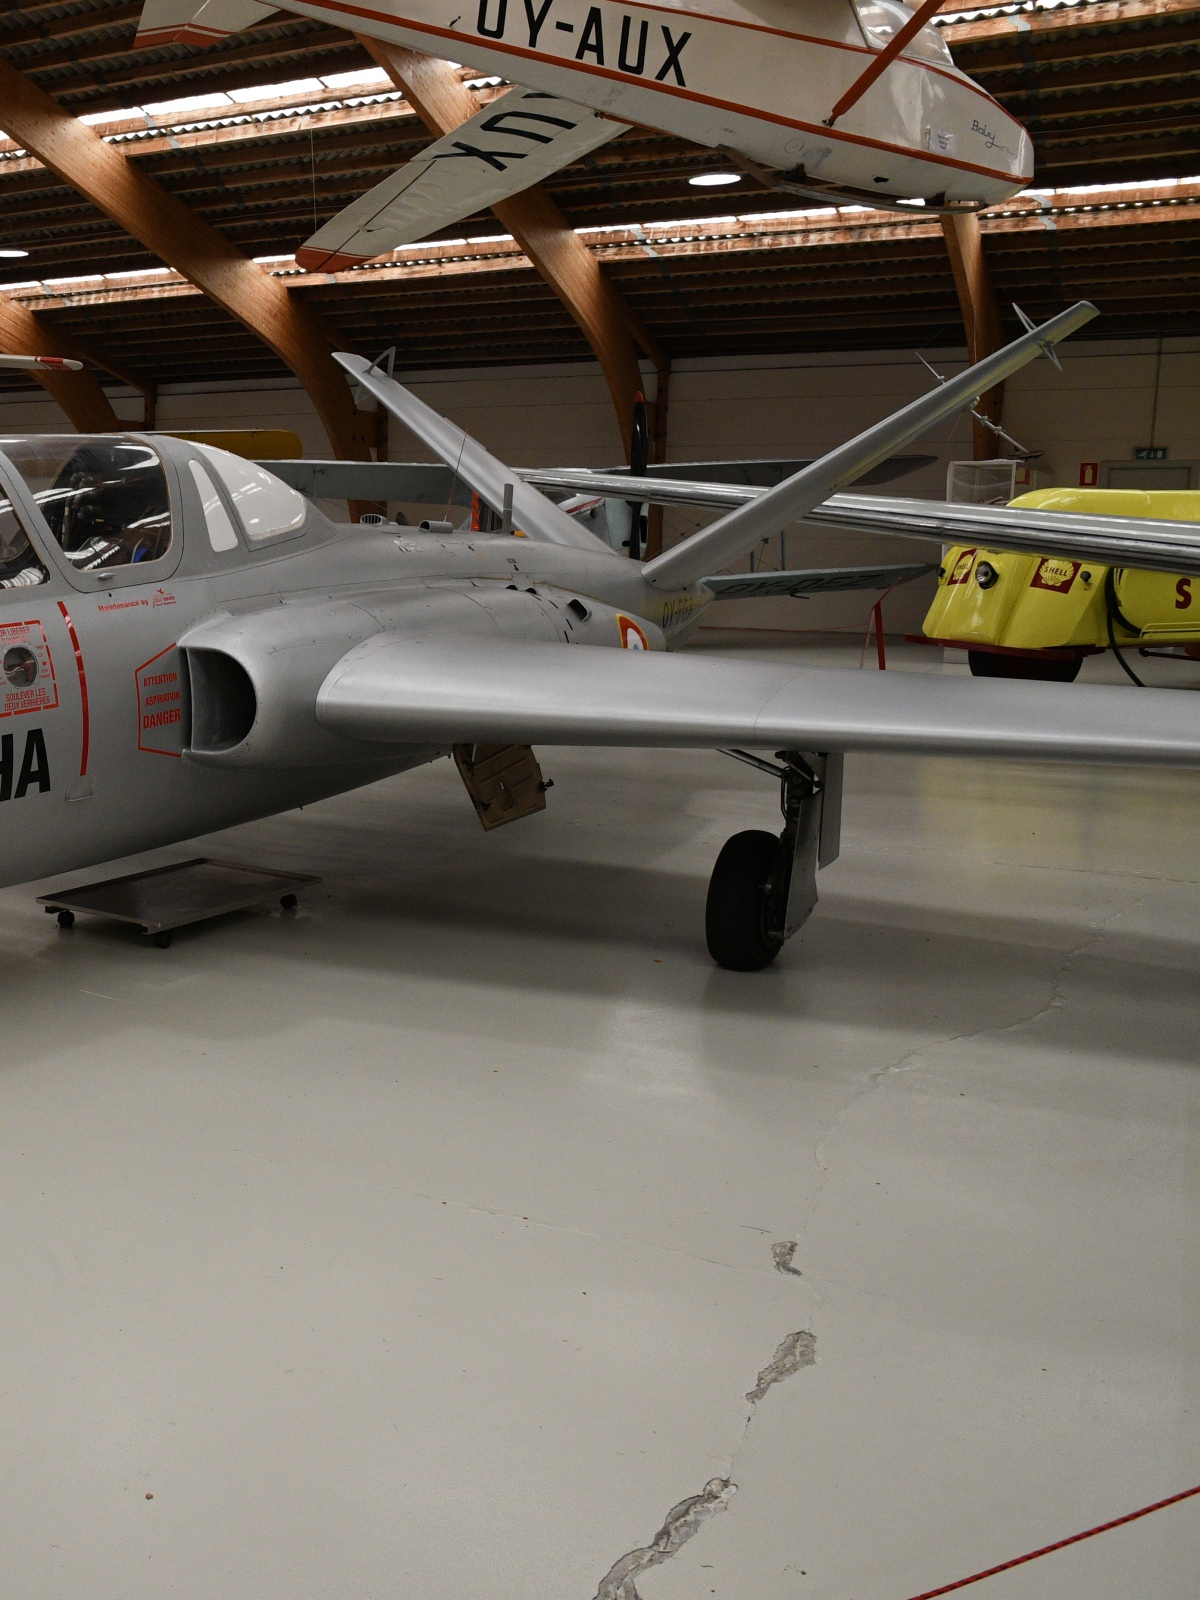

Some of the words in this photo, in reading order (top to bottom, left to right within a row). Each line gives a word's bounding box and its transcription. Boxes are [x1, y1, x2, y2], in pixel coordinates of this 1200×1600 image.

[477, 0, 692, 87] OY-AUX
[1043, 564, 1069, 578] SHELL
[143, 671, 178, 688] ATTENTION
[5, 690, 35, 702] SOULEVER
[35, 687, 47, 697] LES
[145, 690, 181, 707] ASPIRATION
[4, 702, 20, 712] DEUX
[143, 707, 181, 730] DANGER
